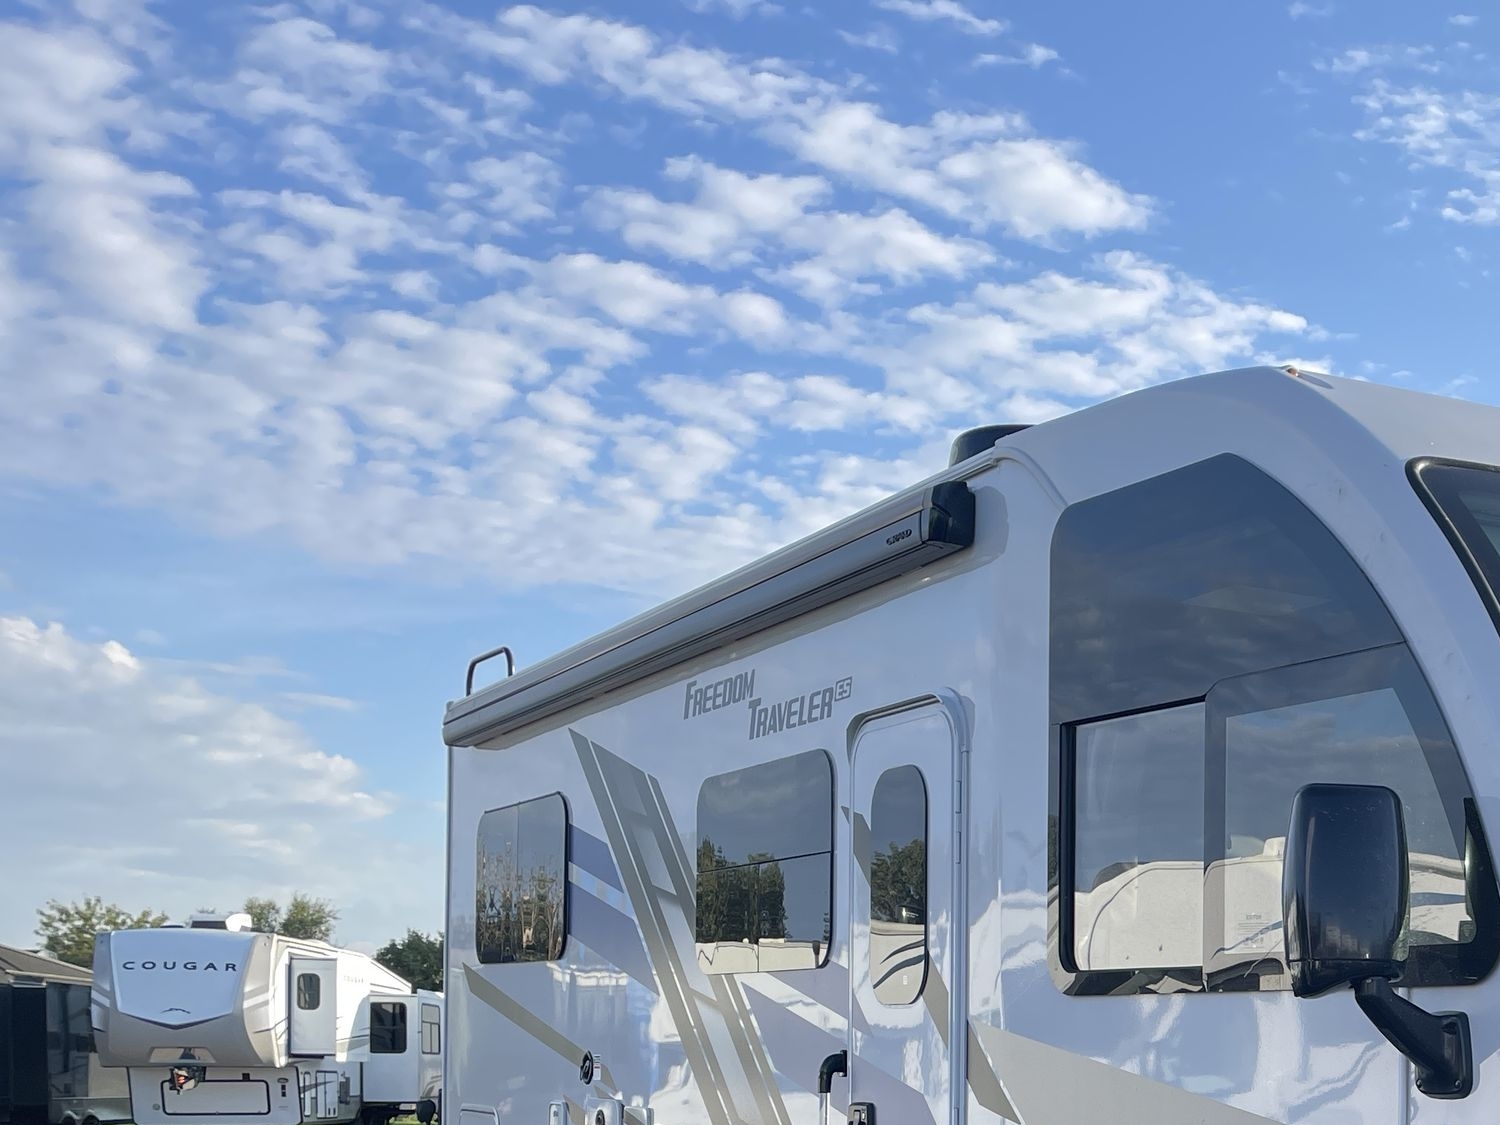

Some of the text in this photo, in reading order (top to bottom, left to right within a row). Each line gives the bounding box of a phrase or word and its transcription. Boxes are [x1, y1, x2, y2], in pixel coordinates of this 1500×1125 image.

[683, 669, 755, 720] FREEDOM
[748, 687, 834, 740] TRAVELER
[122, 961, 237, 972] COUGAR
